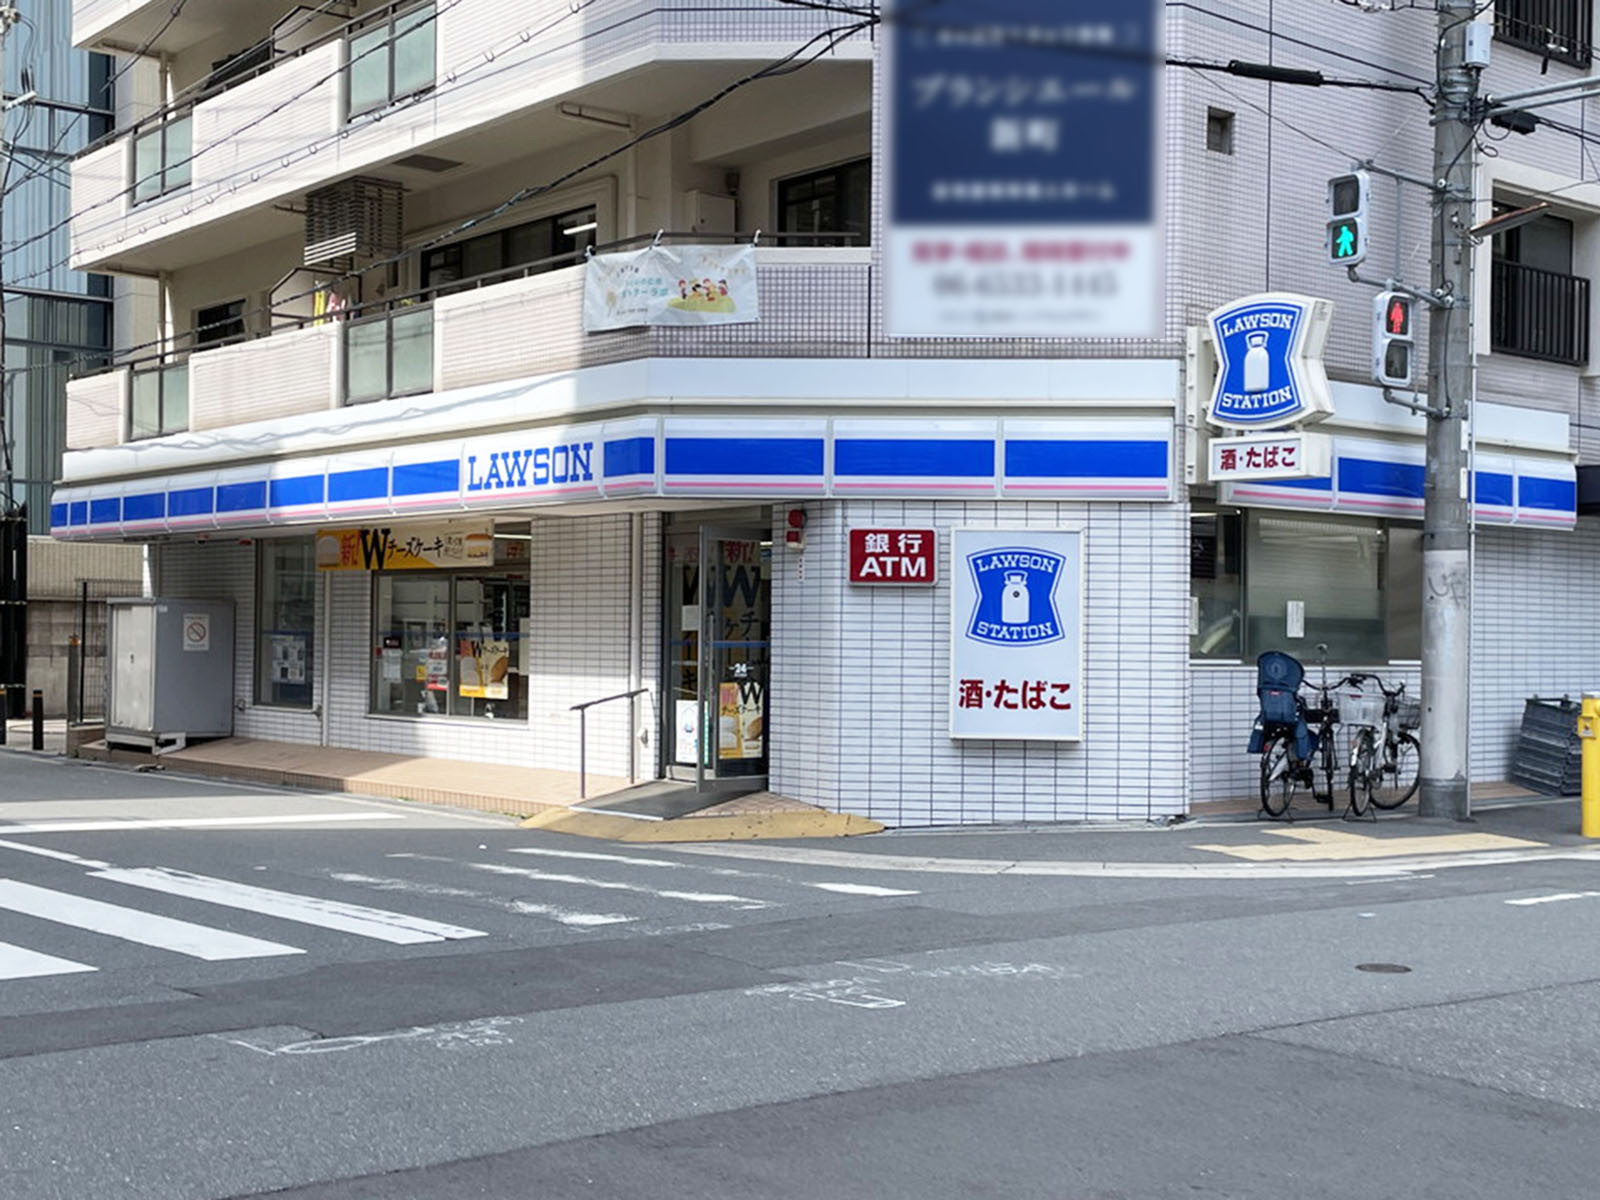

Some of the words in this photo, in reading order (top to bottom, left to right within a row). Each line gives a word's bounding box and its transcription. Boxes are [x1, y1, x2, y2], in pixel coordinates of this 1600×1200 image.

[1222, 312, 1294, 337] LAWSON
[1221, 385, 1293, 409] STATION
[468, 442, 593, 491] LAWSON
[865, 533, 923, 554] 銀行
[859, 557, 927, 577] ATM
[976, 554, 1056, 574] LAWSON
[976, 621, 1054, 640] STATION
[958, 679, 1072, 710] 酒・たばこ
